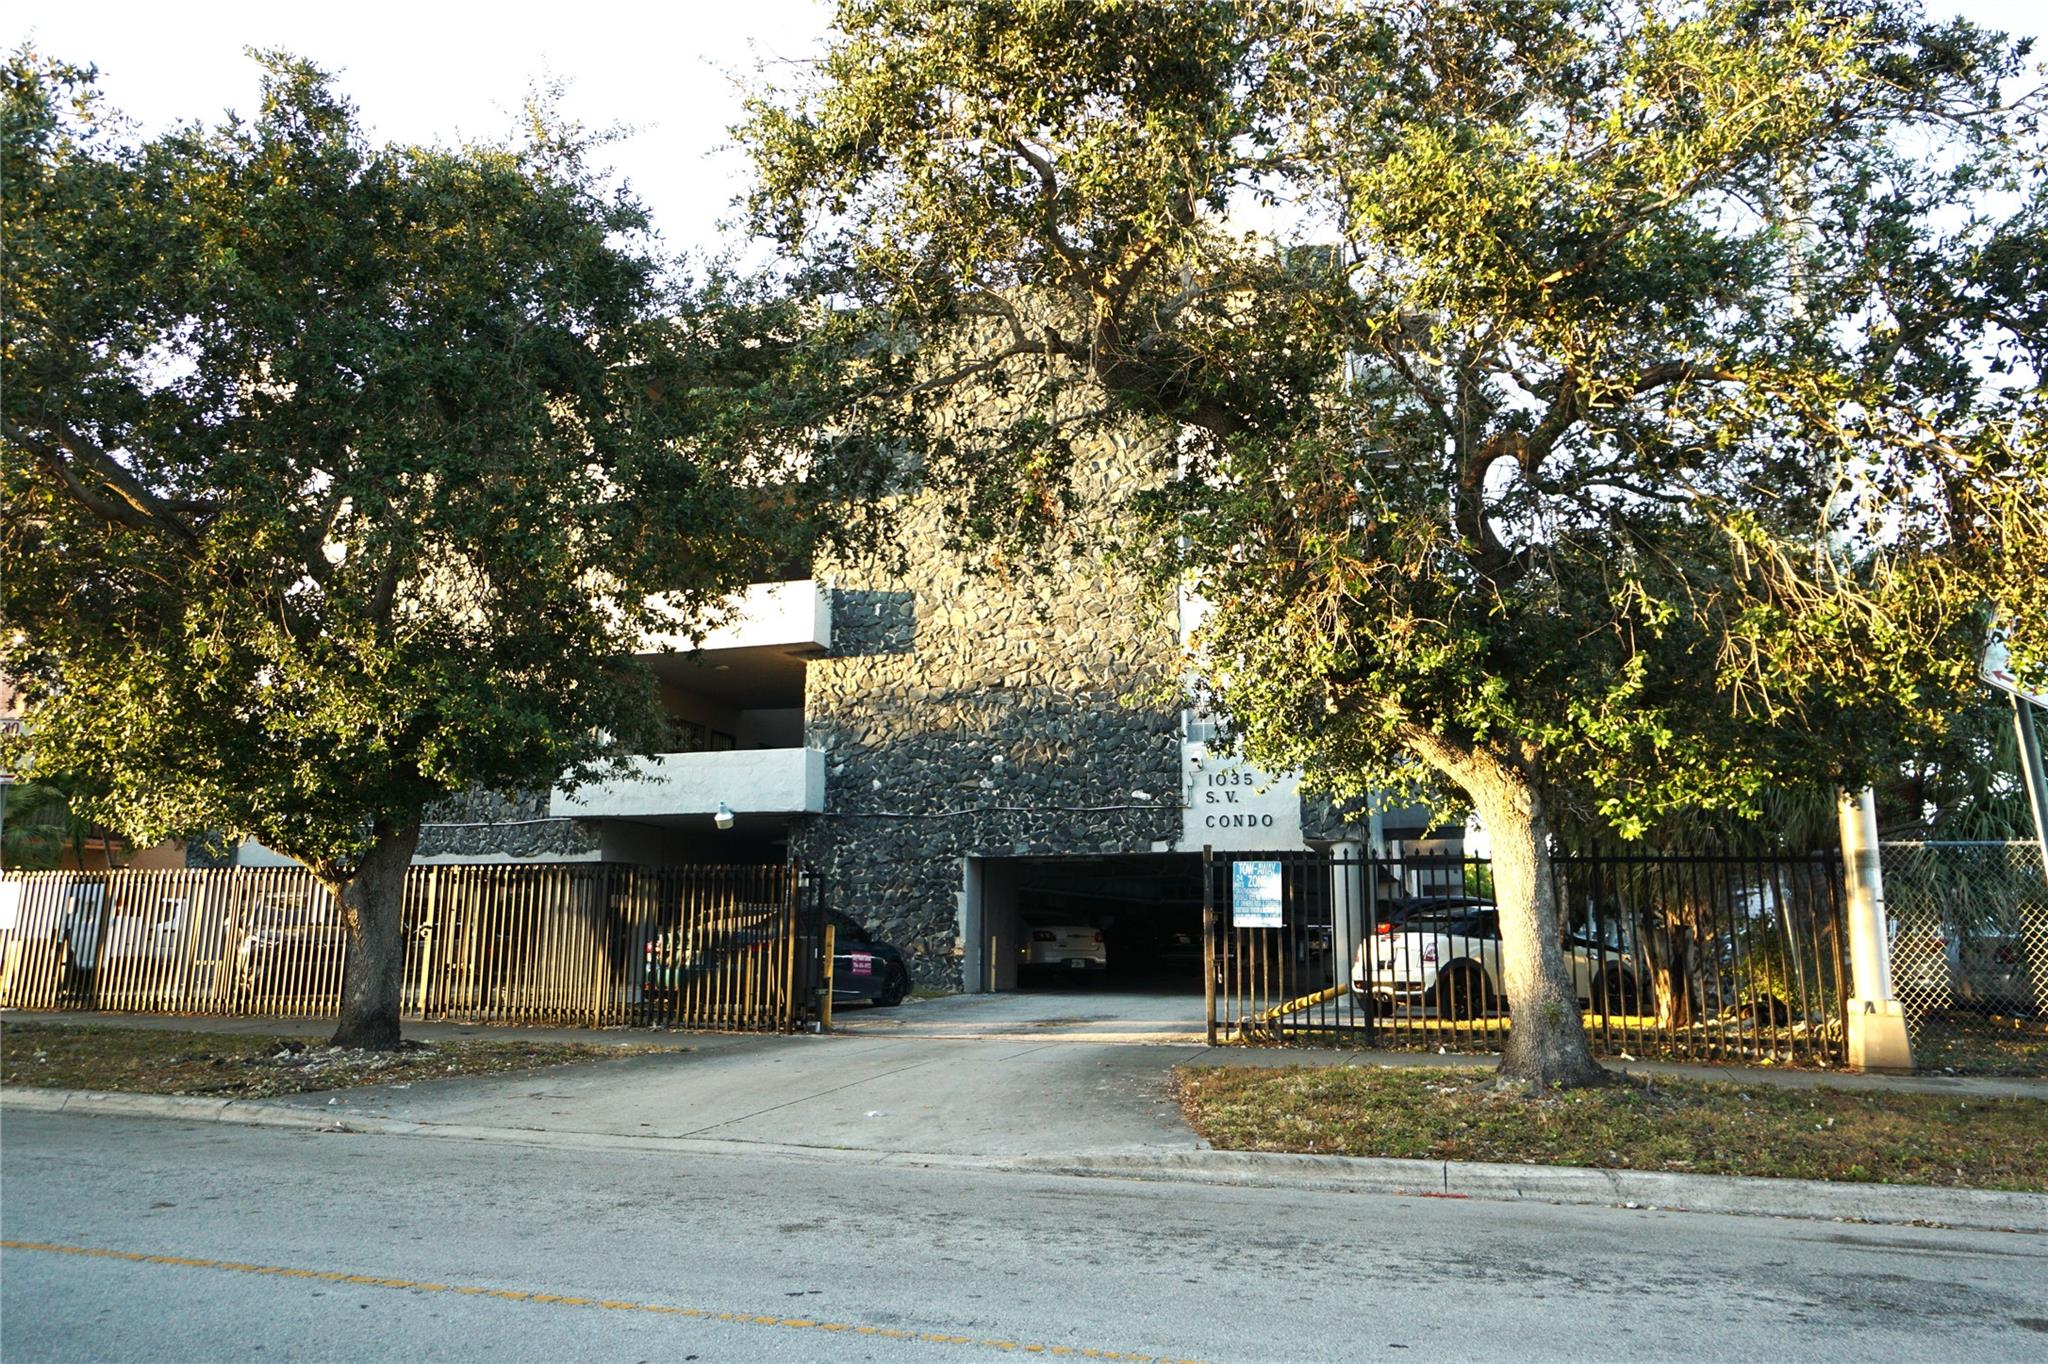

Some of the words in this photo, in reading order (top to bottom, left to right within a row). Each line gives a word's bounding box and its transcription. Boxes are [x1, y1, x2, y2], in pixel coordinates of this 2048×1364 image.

[1208, 773, 1253, 787] 1035
[1205, 791, 1220, 804] S.
[1225, 790, 1239, 803] V.
[1205, 814, 1273, 828] CONDO
